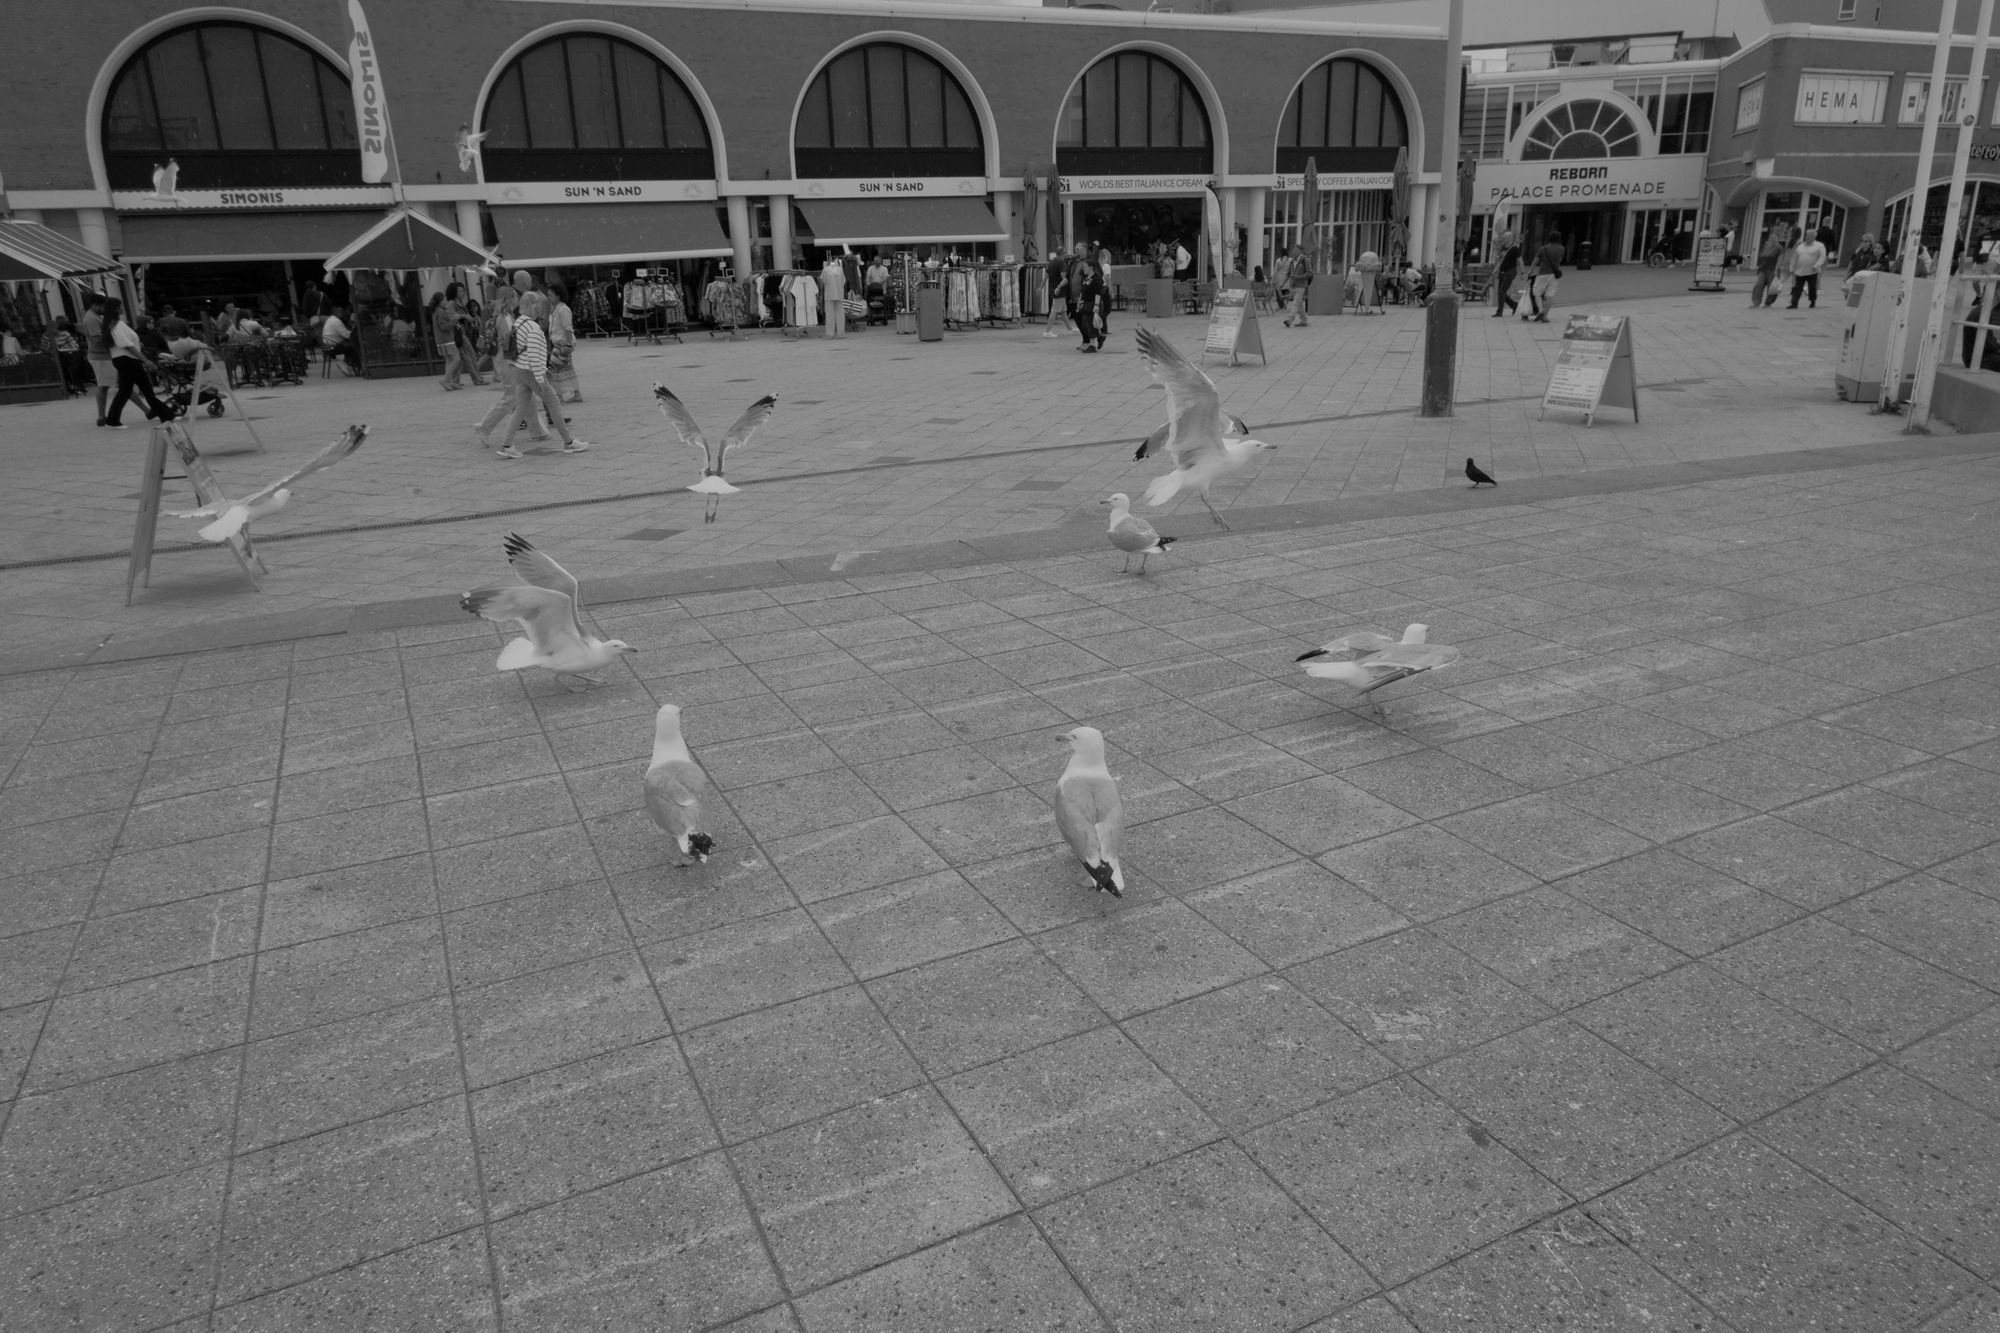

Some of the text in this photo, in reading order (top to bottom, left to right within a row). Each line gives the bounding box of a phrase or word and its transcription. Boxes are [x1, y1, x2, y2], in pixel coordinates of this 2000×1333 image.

[1805, 91, 1858, 108] HEMA
[1550, 166, 1608, 180] REBORN
[859, 183, 880, 192] SUN
[896, 182, 924, 192] SAND
[1079, 180, 1114, 189] WORLDS
[1115, 179, 1134, 189] BEST
[1134, 179, 1163, 188] ITALIAN
[1163, 178, 1175, 188] ICE
[1177, 178, 1202, 188] CREAM
[1321, 177, 1349, 186] COFFEE
[1349, 177, 1354, 185] &
[1354, 176, 1378, 185] ITALIAN
[564, 187, 590, 197] SUN
[608, 185, 642, 197] SAND
[1490, 181, 1666, 199] PALACE PROMENADE
[220, 192, 284, 205] SIMONIS
